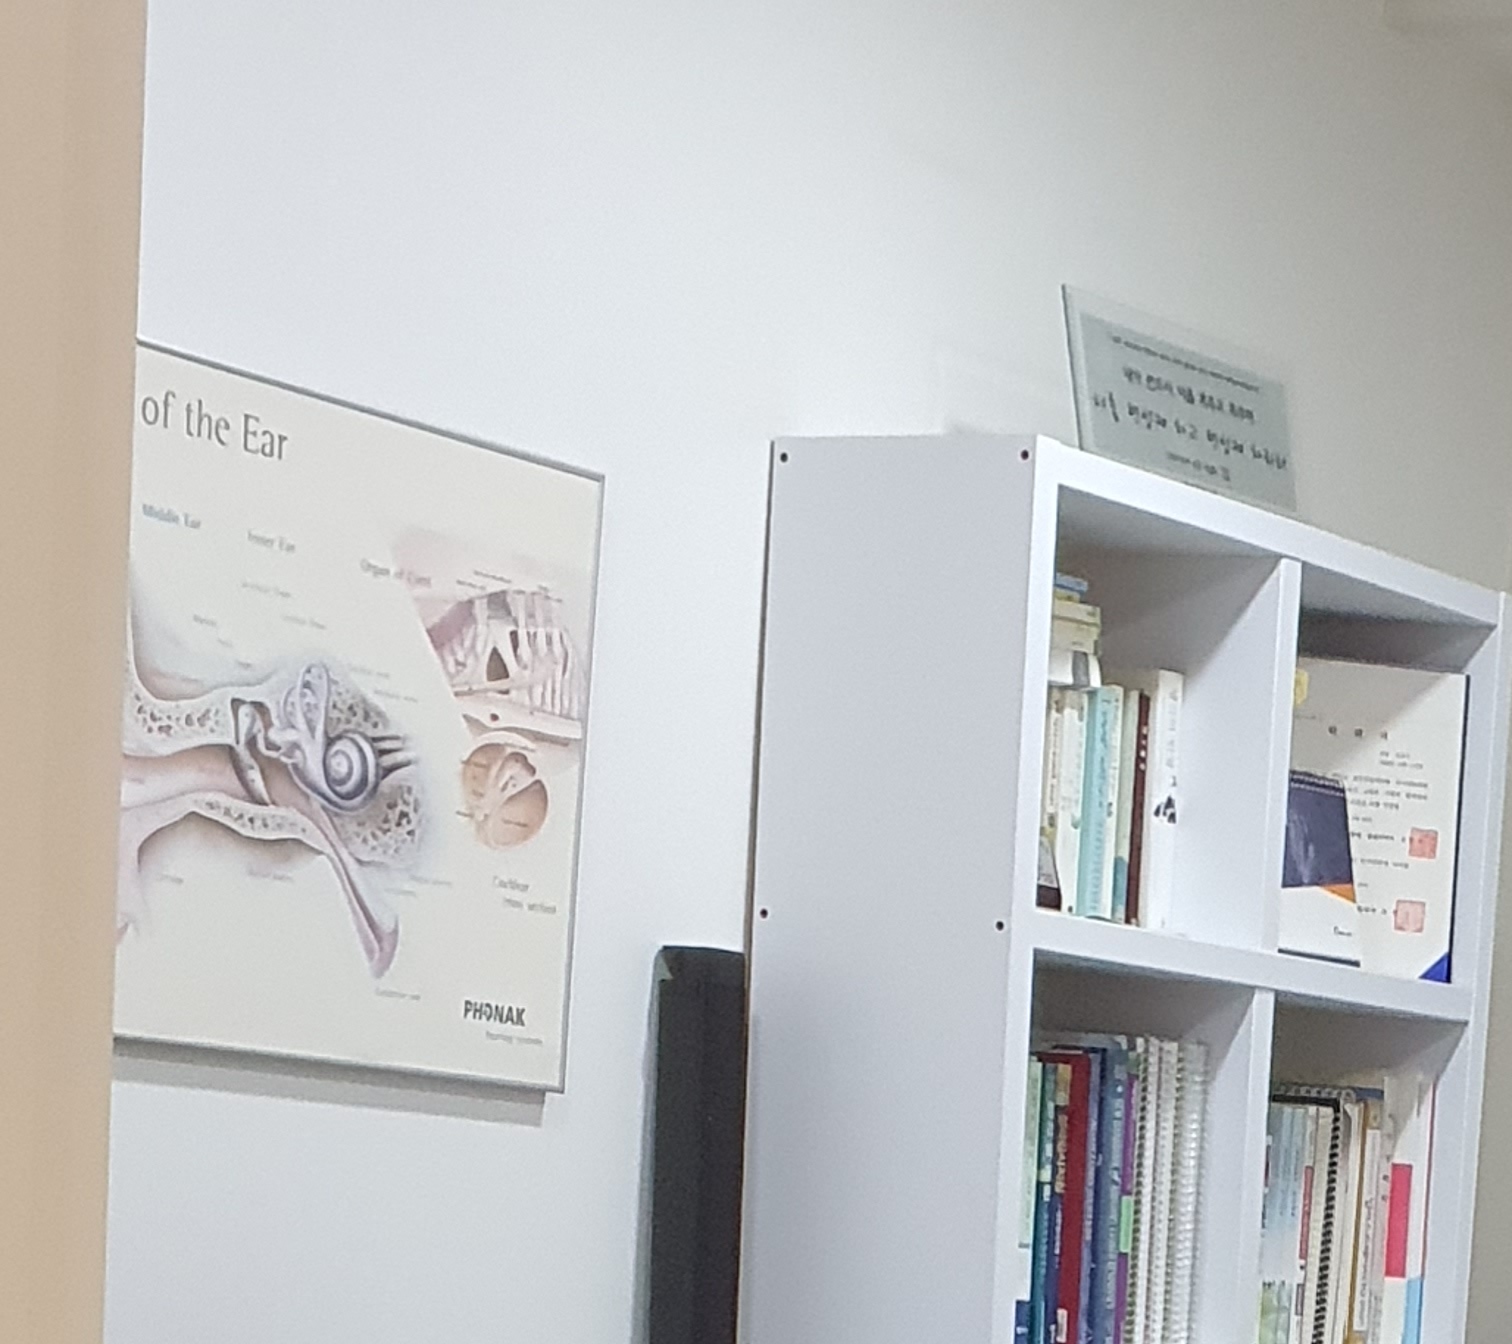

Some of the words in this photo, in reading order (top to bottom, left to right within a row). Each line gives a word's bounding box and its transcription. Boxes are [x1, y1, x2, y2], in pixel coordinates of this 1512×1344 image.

[142, 389, 176, 429] of
[185, 398, 231, 447] the
[243, 413, 289, 461] Ear
[463, 999, 526, 1027] PHONAK
